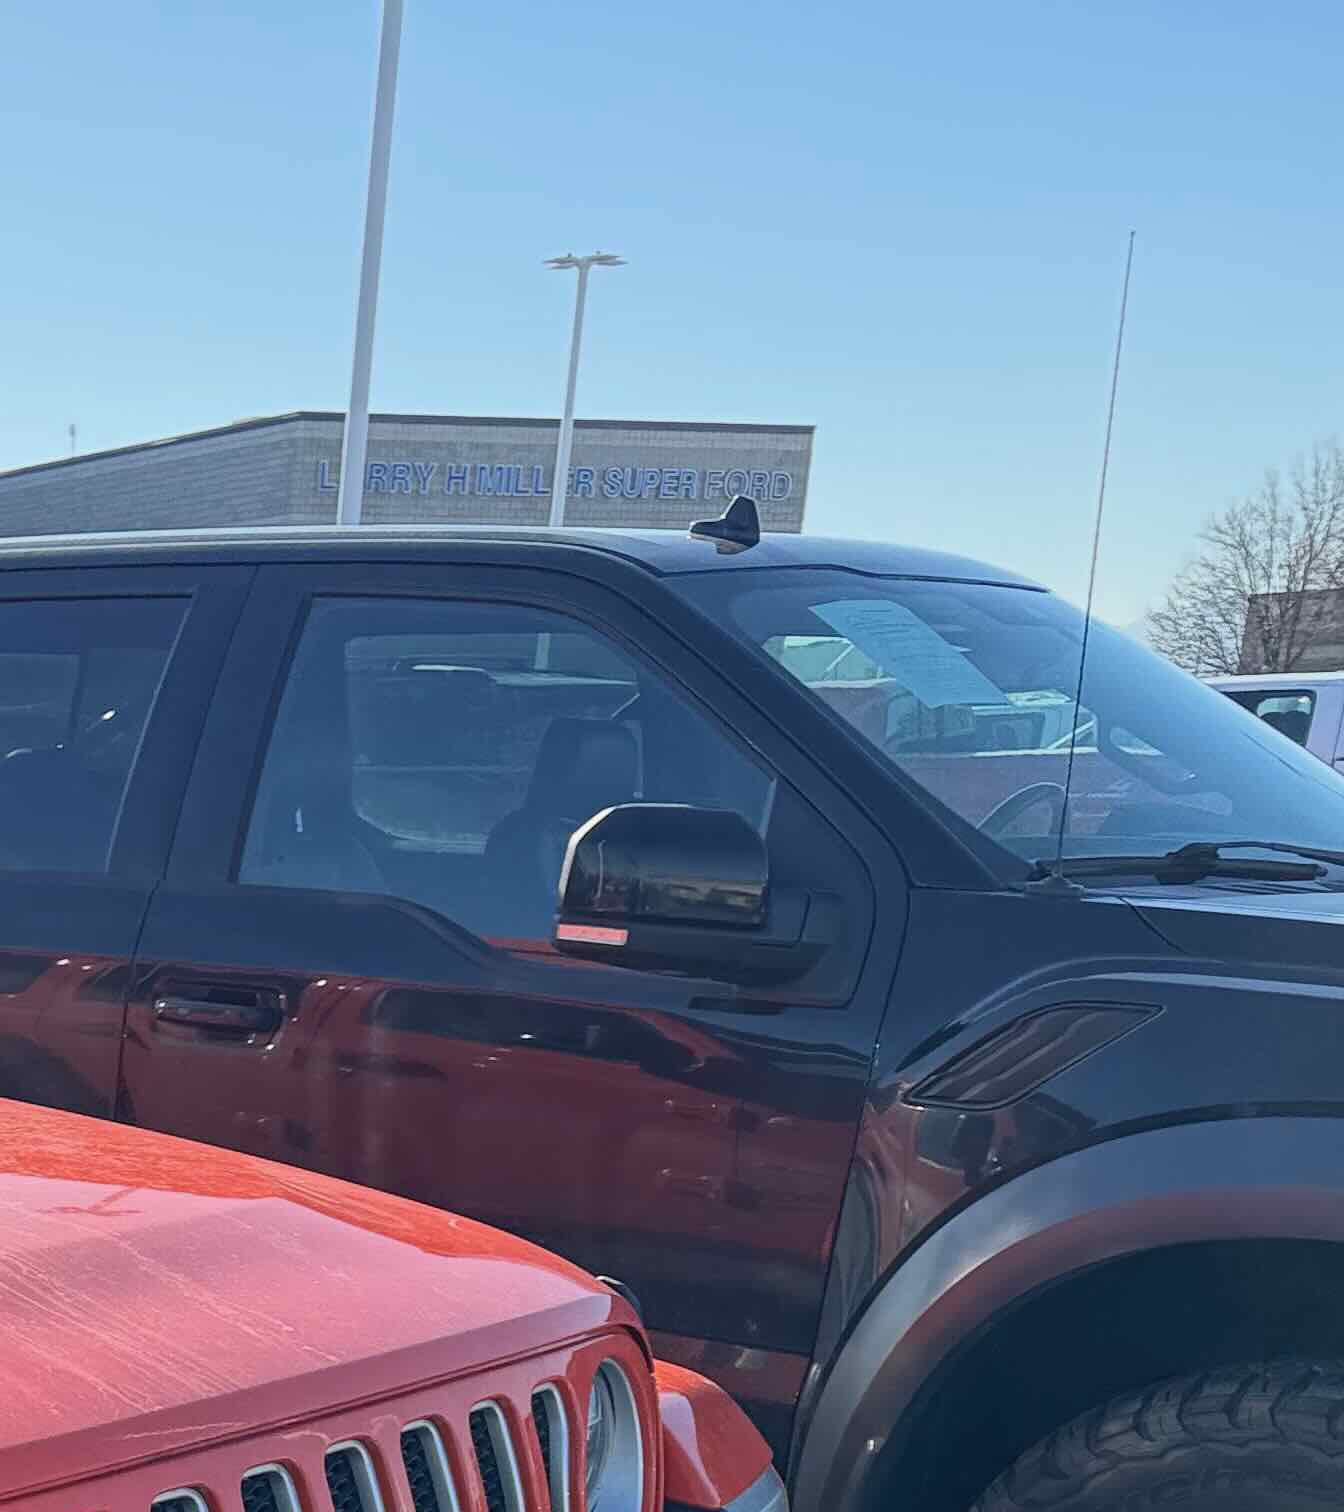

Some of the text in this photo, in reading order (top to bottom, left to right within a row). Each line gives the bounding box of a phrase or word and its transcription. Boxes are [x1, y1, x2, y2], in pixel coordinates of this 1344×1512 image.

[318, 459, 438, 496] LRRY
[444, 463, 467, 496] H
[604, 466, 699, 499] SUPER
[704, 469, 792, 501] FORD
